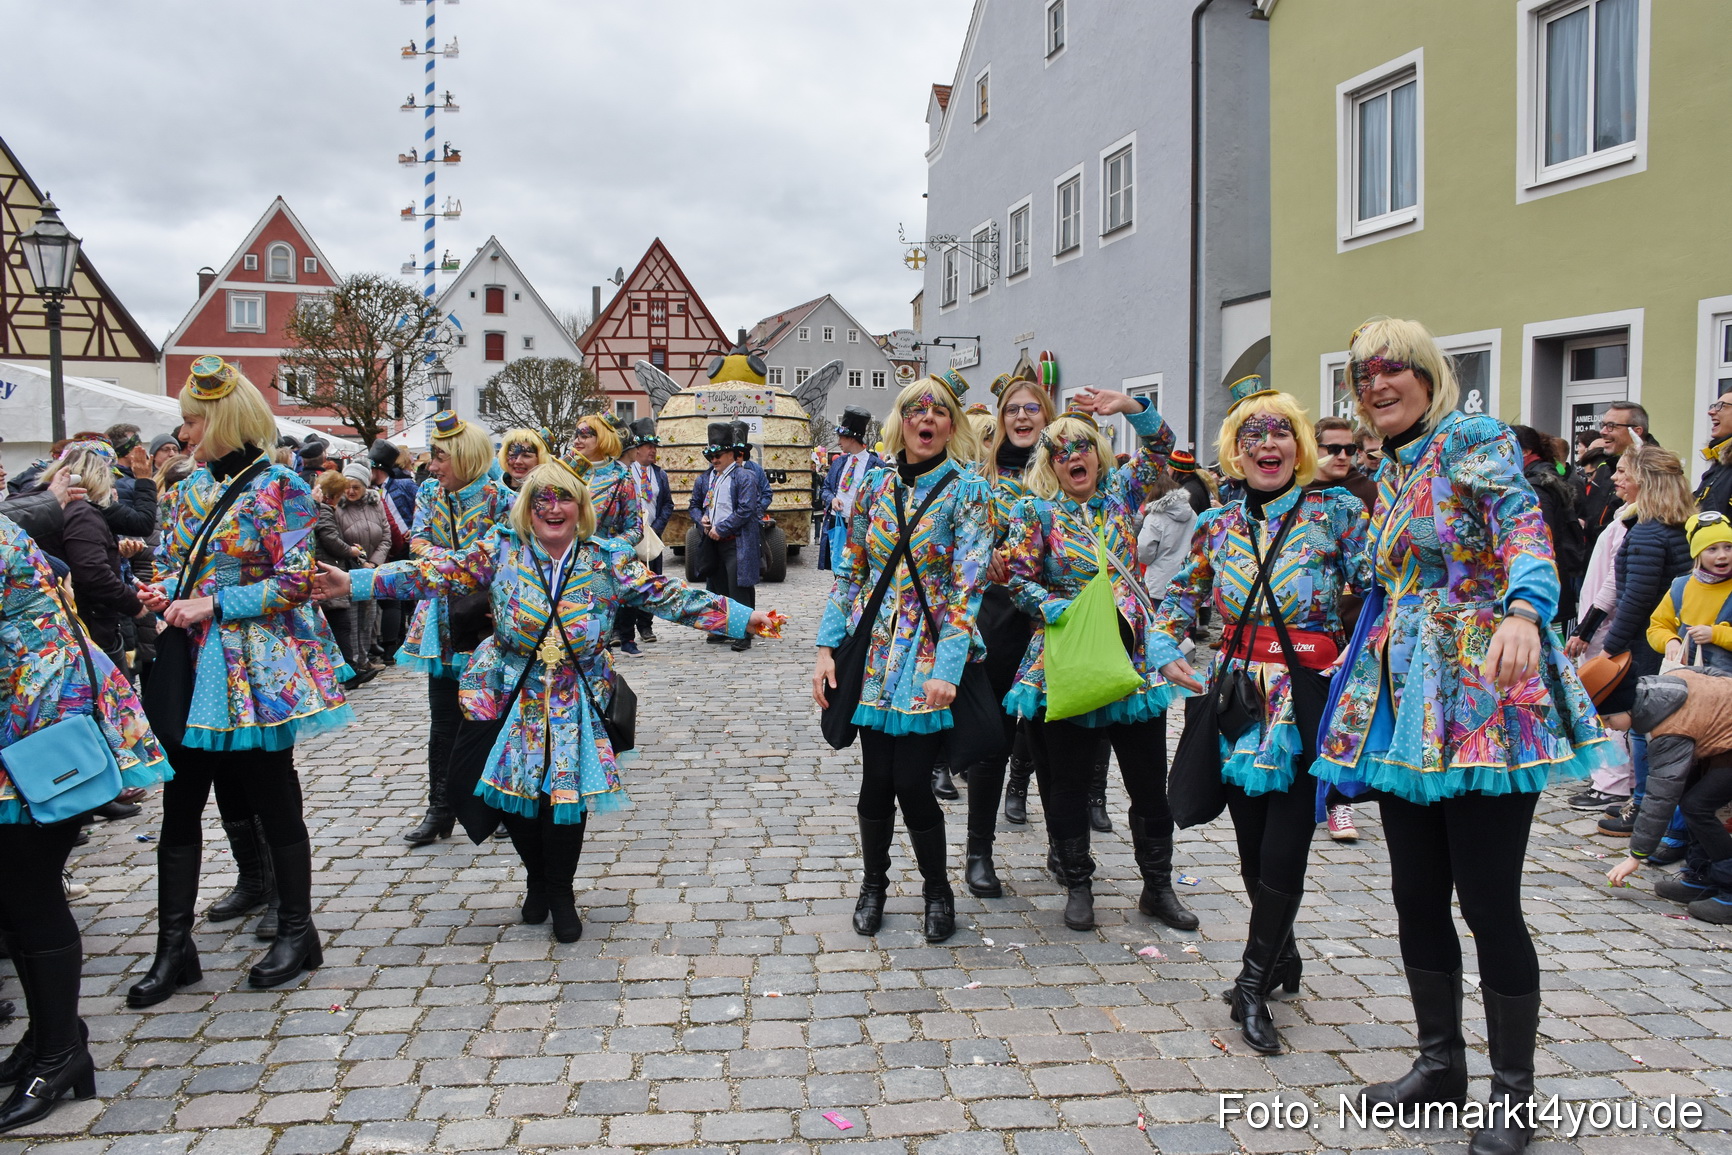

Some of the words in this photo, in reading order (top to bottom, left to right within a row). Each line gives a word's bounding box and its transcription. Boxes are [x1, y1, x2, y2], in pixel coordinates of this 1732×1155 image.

[1464, 389, 1483, 414] &
[723, 403, 759, 414] Bienchen
[1575, 415, 1604, 423] ANMELDUN
[1267, 641, 1316, 653] Bentzen
